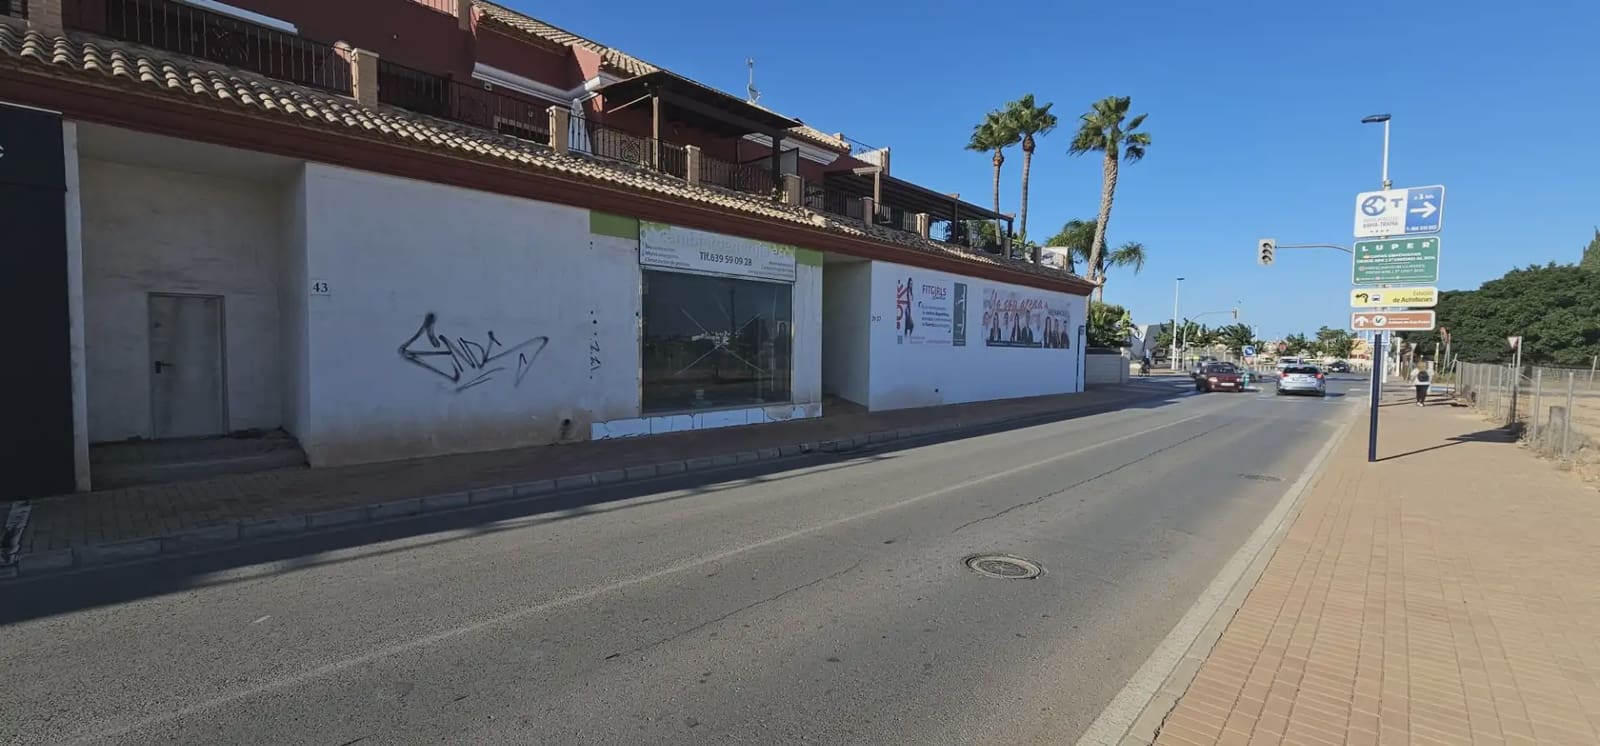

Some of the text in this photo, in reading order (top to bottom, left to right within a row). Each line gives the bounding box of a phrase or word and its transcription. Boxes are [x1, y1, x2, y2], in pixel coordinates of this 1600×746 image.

[1362, 241, 1430, 252] LUPER
[724, 254, 734, 265] 59
[734, 256, 744, 266] 09
[744, 257, 753, 267] 28
[312, 281, 329, 293] 43
